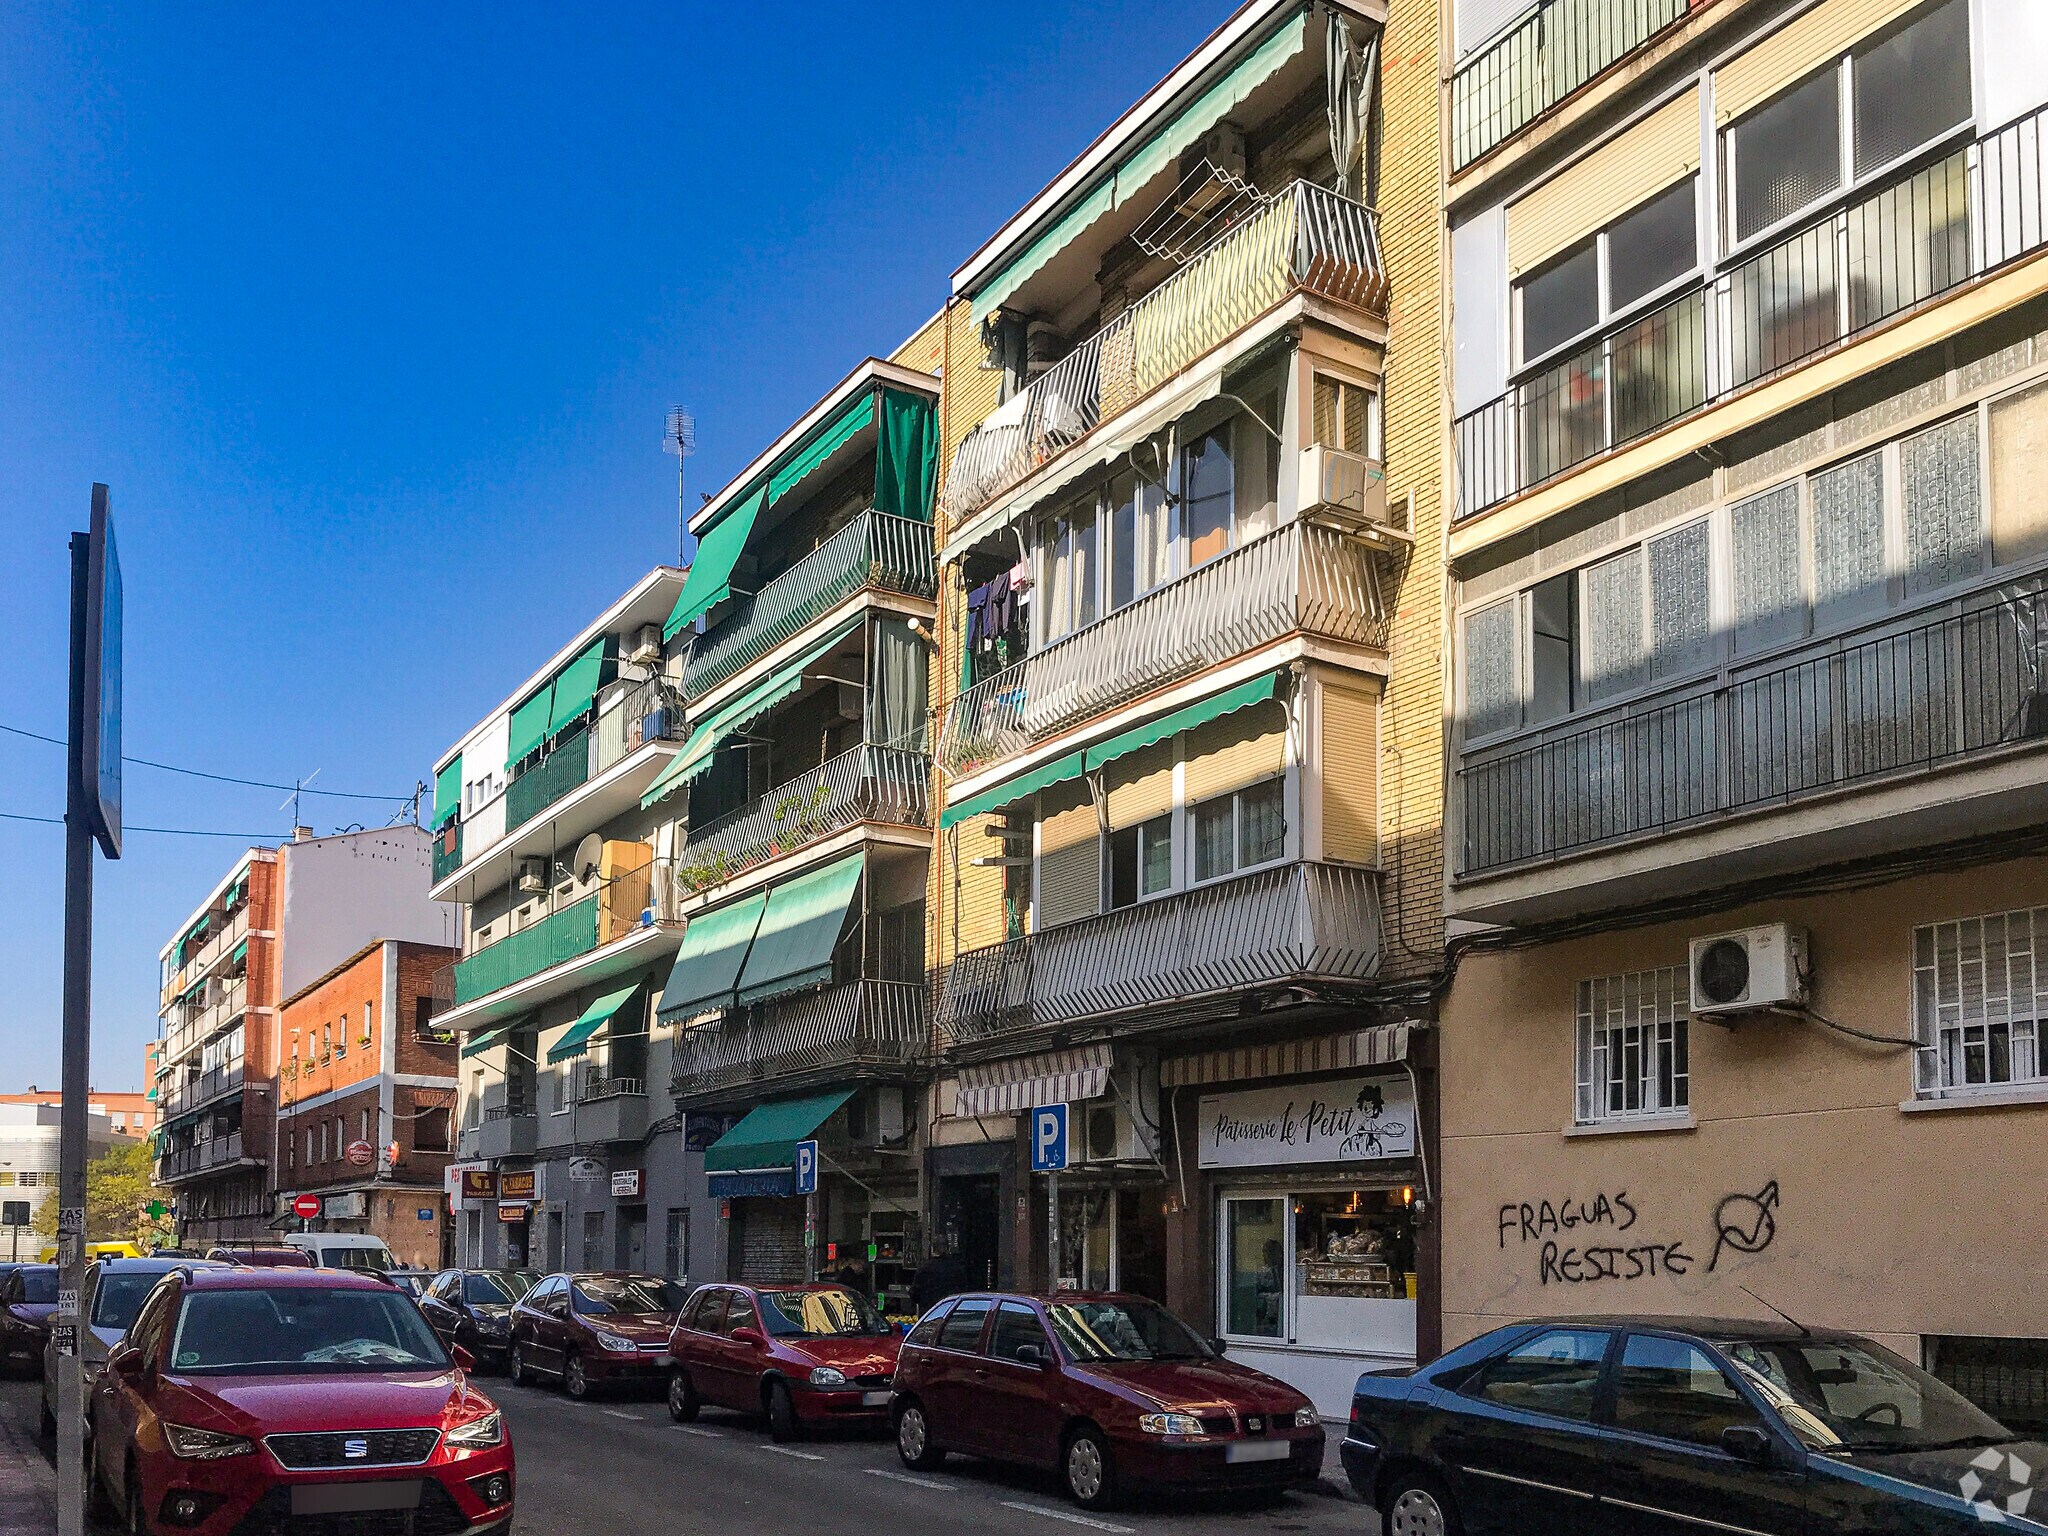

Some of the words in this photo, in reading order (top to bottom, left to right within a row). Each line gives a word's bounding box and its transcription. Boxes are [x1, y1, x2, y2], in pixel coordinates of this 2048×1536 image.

[1212, 1113, 1279, 1148] Pâtisserie
[1279, 1101, 1299, 1146] Le
[1300, 1100, 1357, 1144] Petit
[1499, 1191, 1637, 1249] FRAGUAS
[1540, 1240, 1695, 1286] RESISTE
